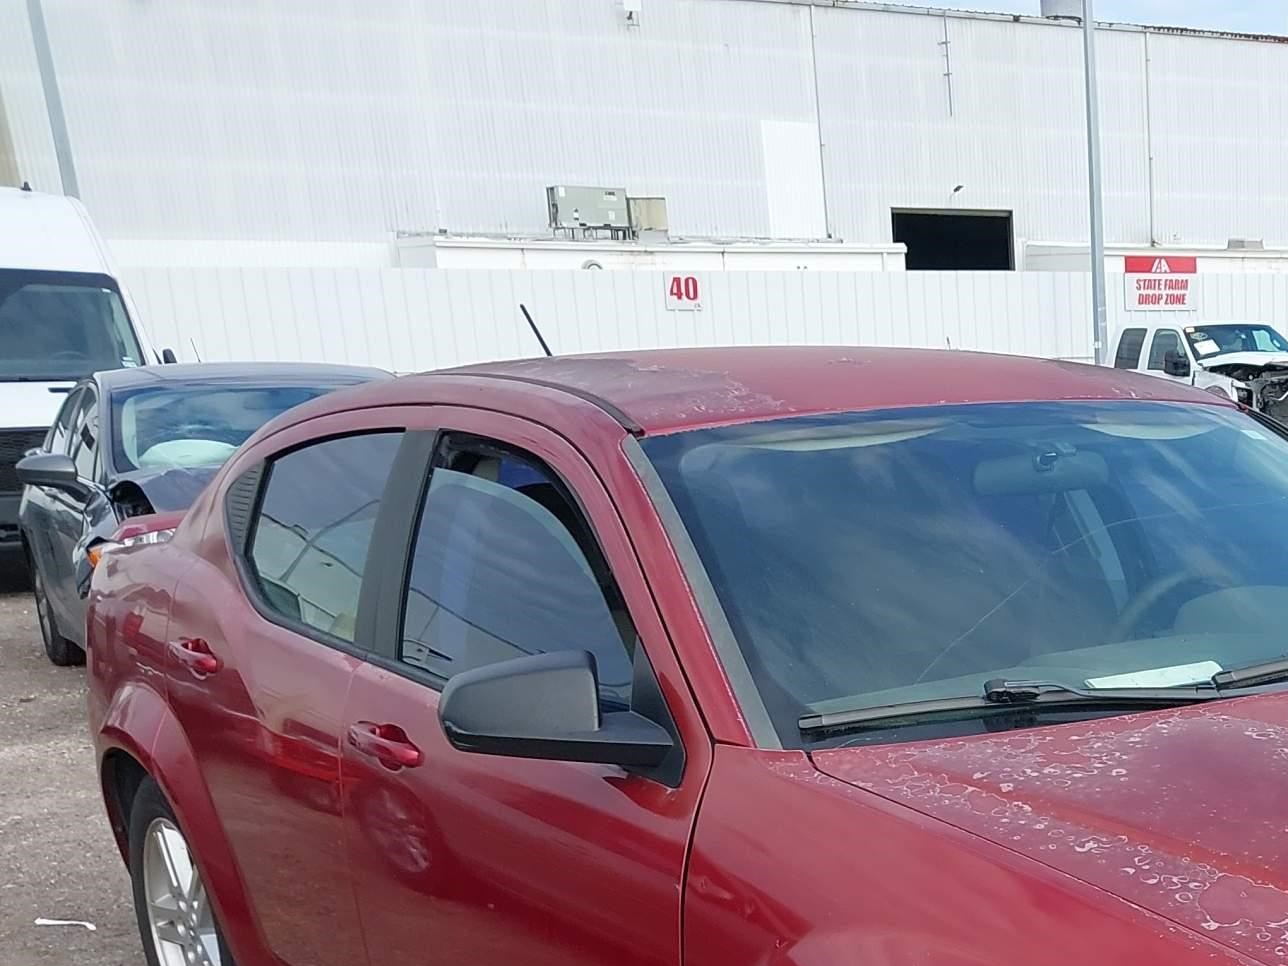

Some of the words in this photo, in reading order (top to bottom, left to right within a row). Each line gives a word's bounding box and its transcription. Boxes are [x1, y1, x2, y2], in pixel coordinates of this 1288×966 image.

[669, 276, 698, 300] 40
[1136, 279, 1162, 291] STATE
[1164, 279, 1188, 291] FARM
[1138, 294, 1163, 305] DROP
[1164, 294, 1186, 305] ZONE
